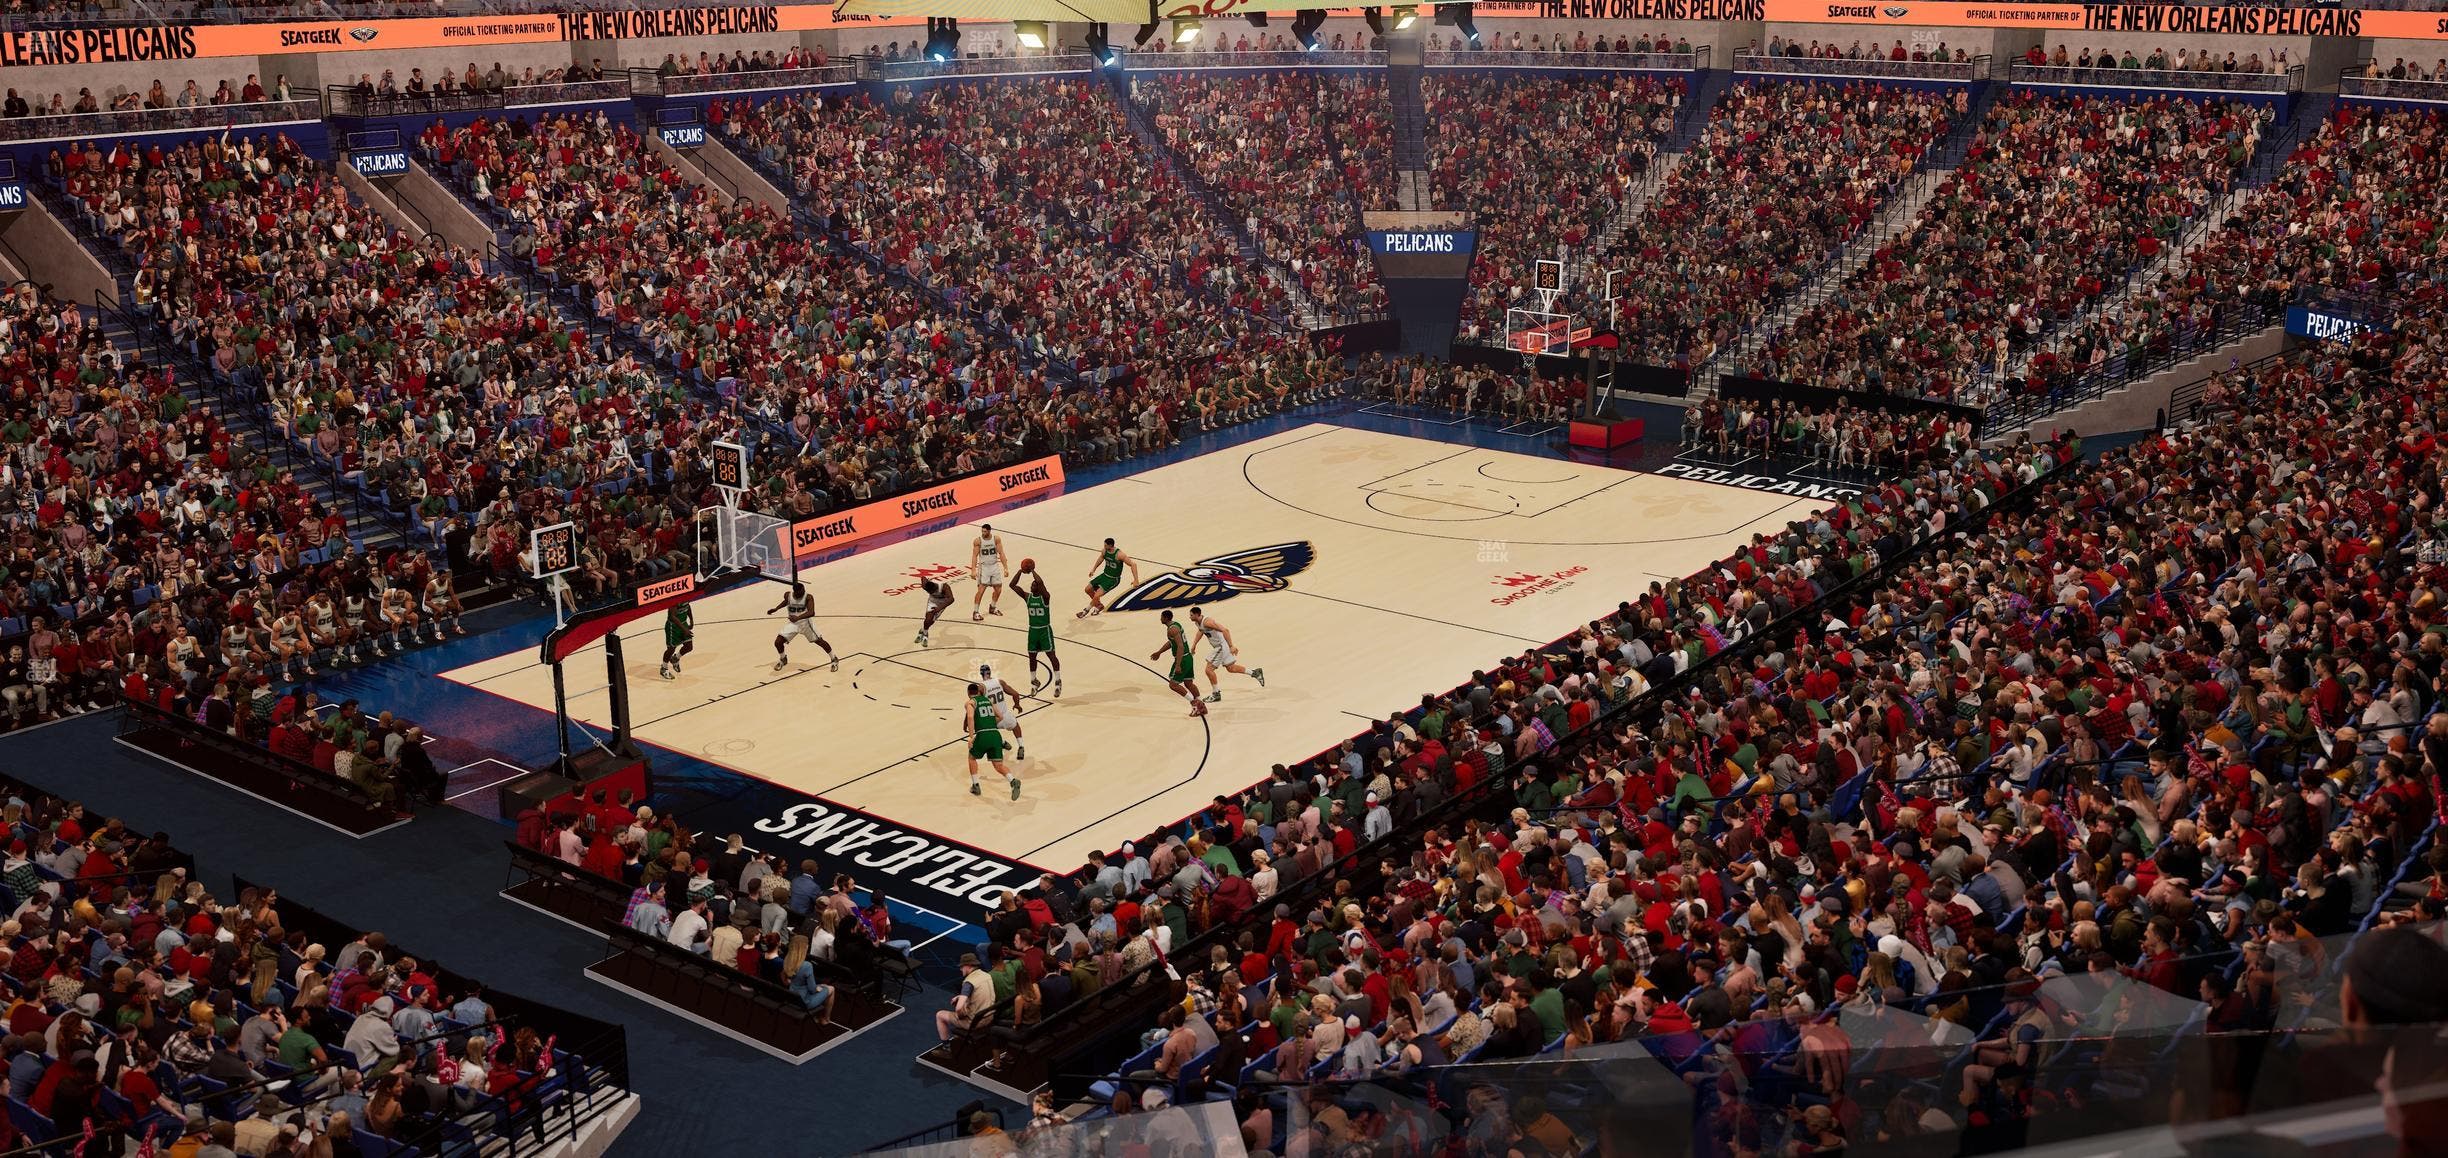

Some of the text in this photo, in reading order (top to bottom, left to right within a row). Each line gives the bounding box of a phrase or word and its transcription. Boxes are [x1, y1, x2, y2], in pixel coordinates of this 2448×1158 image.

[443, 6, 778, 41] OFFICIAL TICKETING PARTNER OF THE NEW ORLEANS PELICANS
[1498, 2, 1526, 10] PARTNER
[1527, 2, 1536, 10] OF
[1539, 0, 1567, 18] THE
[1571, 0, 1606, 18] NEW
[1611, 0, 1687, 20] ORLEANS
[1690, 0, 1765, 21] PELICANS
[1828, 5, 1877, 18] SEATGEEK
[1966, 5, 2361, 36] OFFICIAL TICKETING PARTNER OF THE NEW ORLEANS PELICANS
[82, 27, 197, 62] PELICANS
[281, 28, 342, 46] SEATGEEK
[1385, 234, 1453, 252] PELICANS
[2306, 312, 2370, 343] PELICA
[1000, 464, 1050, 491] SEATGEEK
[1654, 463, 1862, 500] PELICANS
[902, 489, 958, 518] SEATGEEK
[796, 516, 856, 547] SEATGEEK
[643, 578, 690, 601] SEATGEEK
[1490, 579, 1558, 606] SMOOTHIE
[753, 803, 1042, 909] PELICANS
